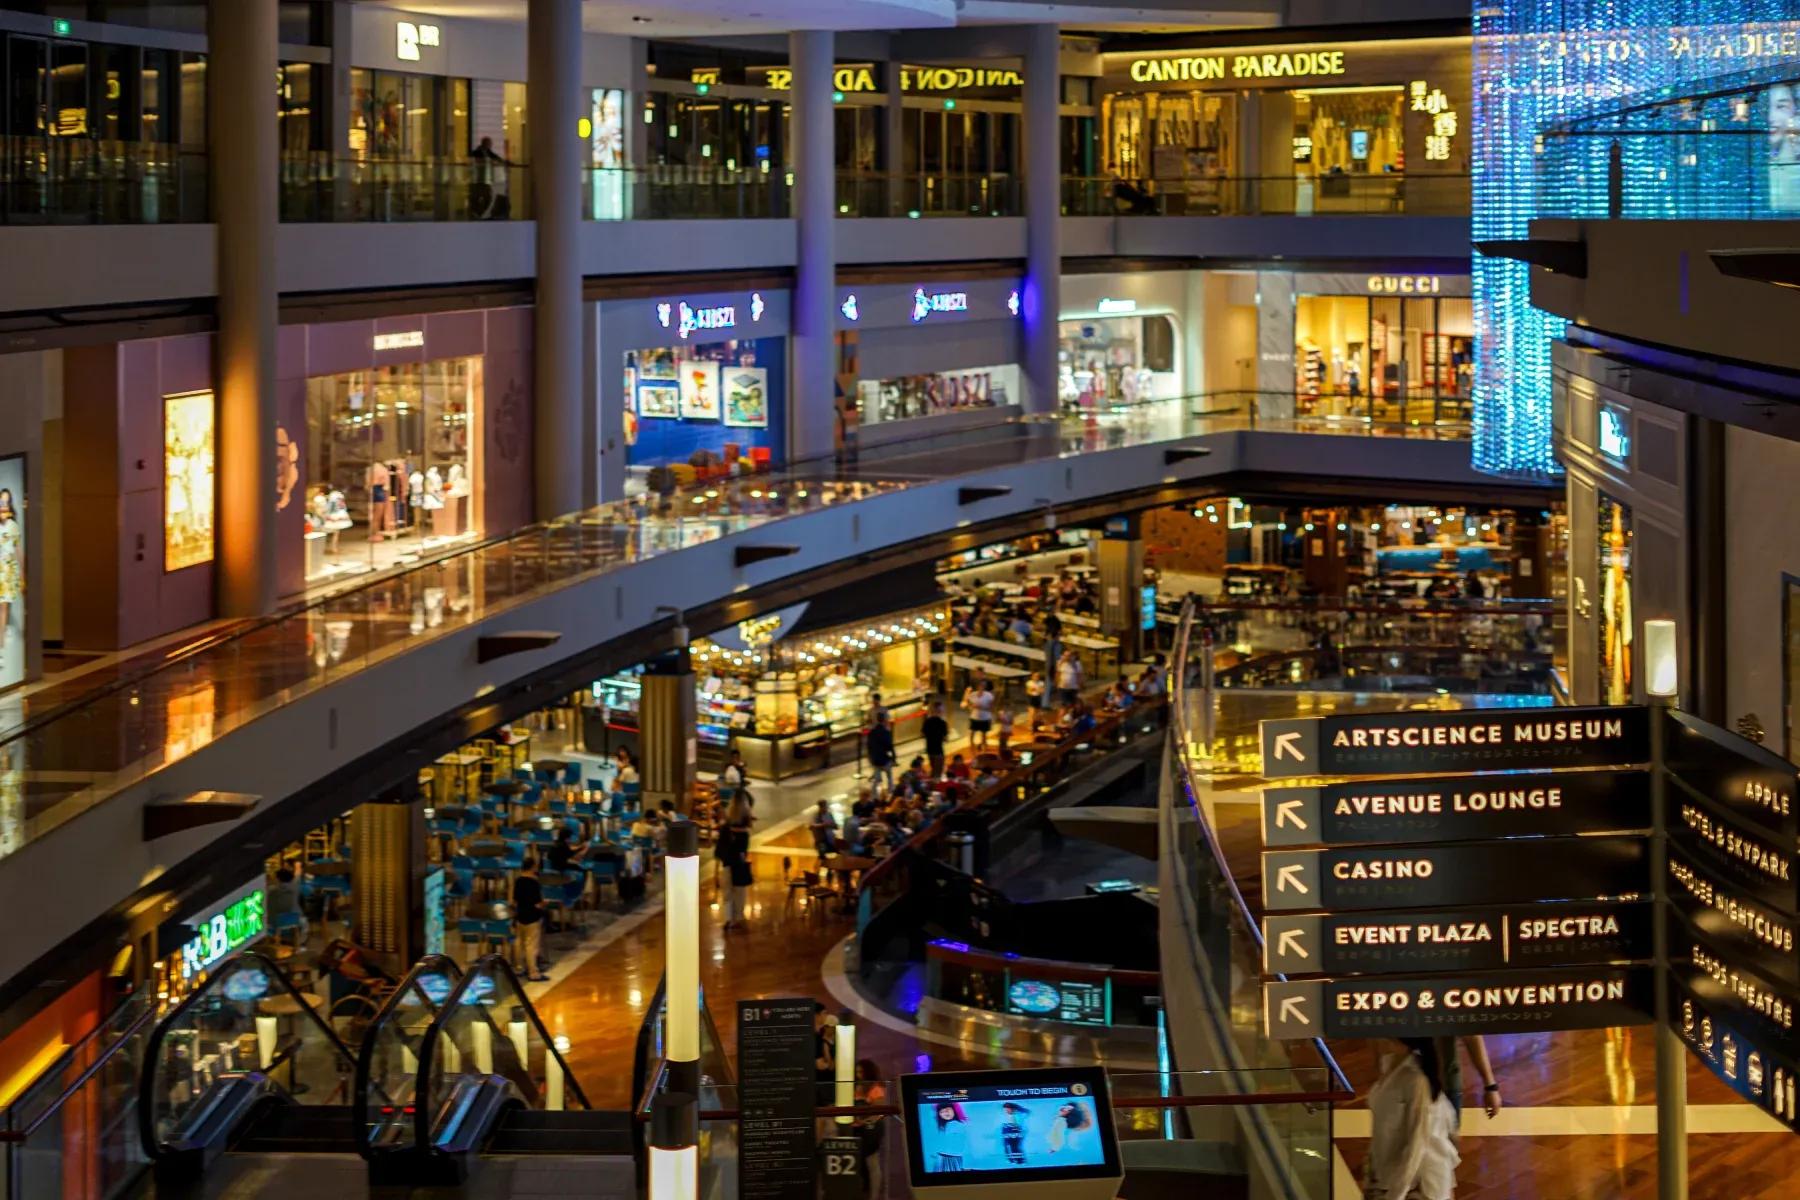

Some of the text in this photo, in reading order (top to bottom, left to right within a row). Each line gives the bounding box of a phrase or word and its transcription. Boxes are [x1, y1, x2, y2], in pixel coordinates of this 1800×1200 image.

[1131, 51, 1345, 82] CANTON PARADISE
[1368, 277, 1440, 293] GUCCI
[1333, 719, 1622, 747] ARTSCIENCE MUSEUM
[1334, 789, 1562, 815] AVENUE LOUNGE
[1744, 781, 1790, 816] APPLE
[1682, 803, 1790, 881] HOTEL & SKYPARK
[1333, 859, 1434, 879] CASINO
[1334, 923, 1492, 945] EVENT PLAZA
[1519, 915, 1619, 939] SPECTRA
[1715, 893, 1793, 951] NIGHTCLUB
[1336, 979, 1624, 1011] EXPO & CONVENTION
[1730, 974, 1793, 1029] THEATRE
[743, 1008, 760, 1022] B1
[996, 1089, 1027, 1097] TOUCH
[1041, 1087, 1068, 1095] BEGIN
[825, 1141, 858, 1150] LEVEL
[826, 1155, 857, 1175] B2
